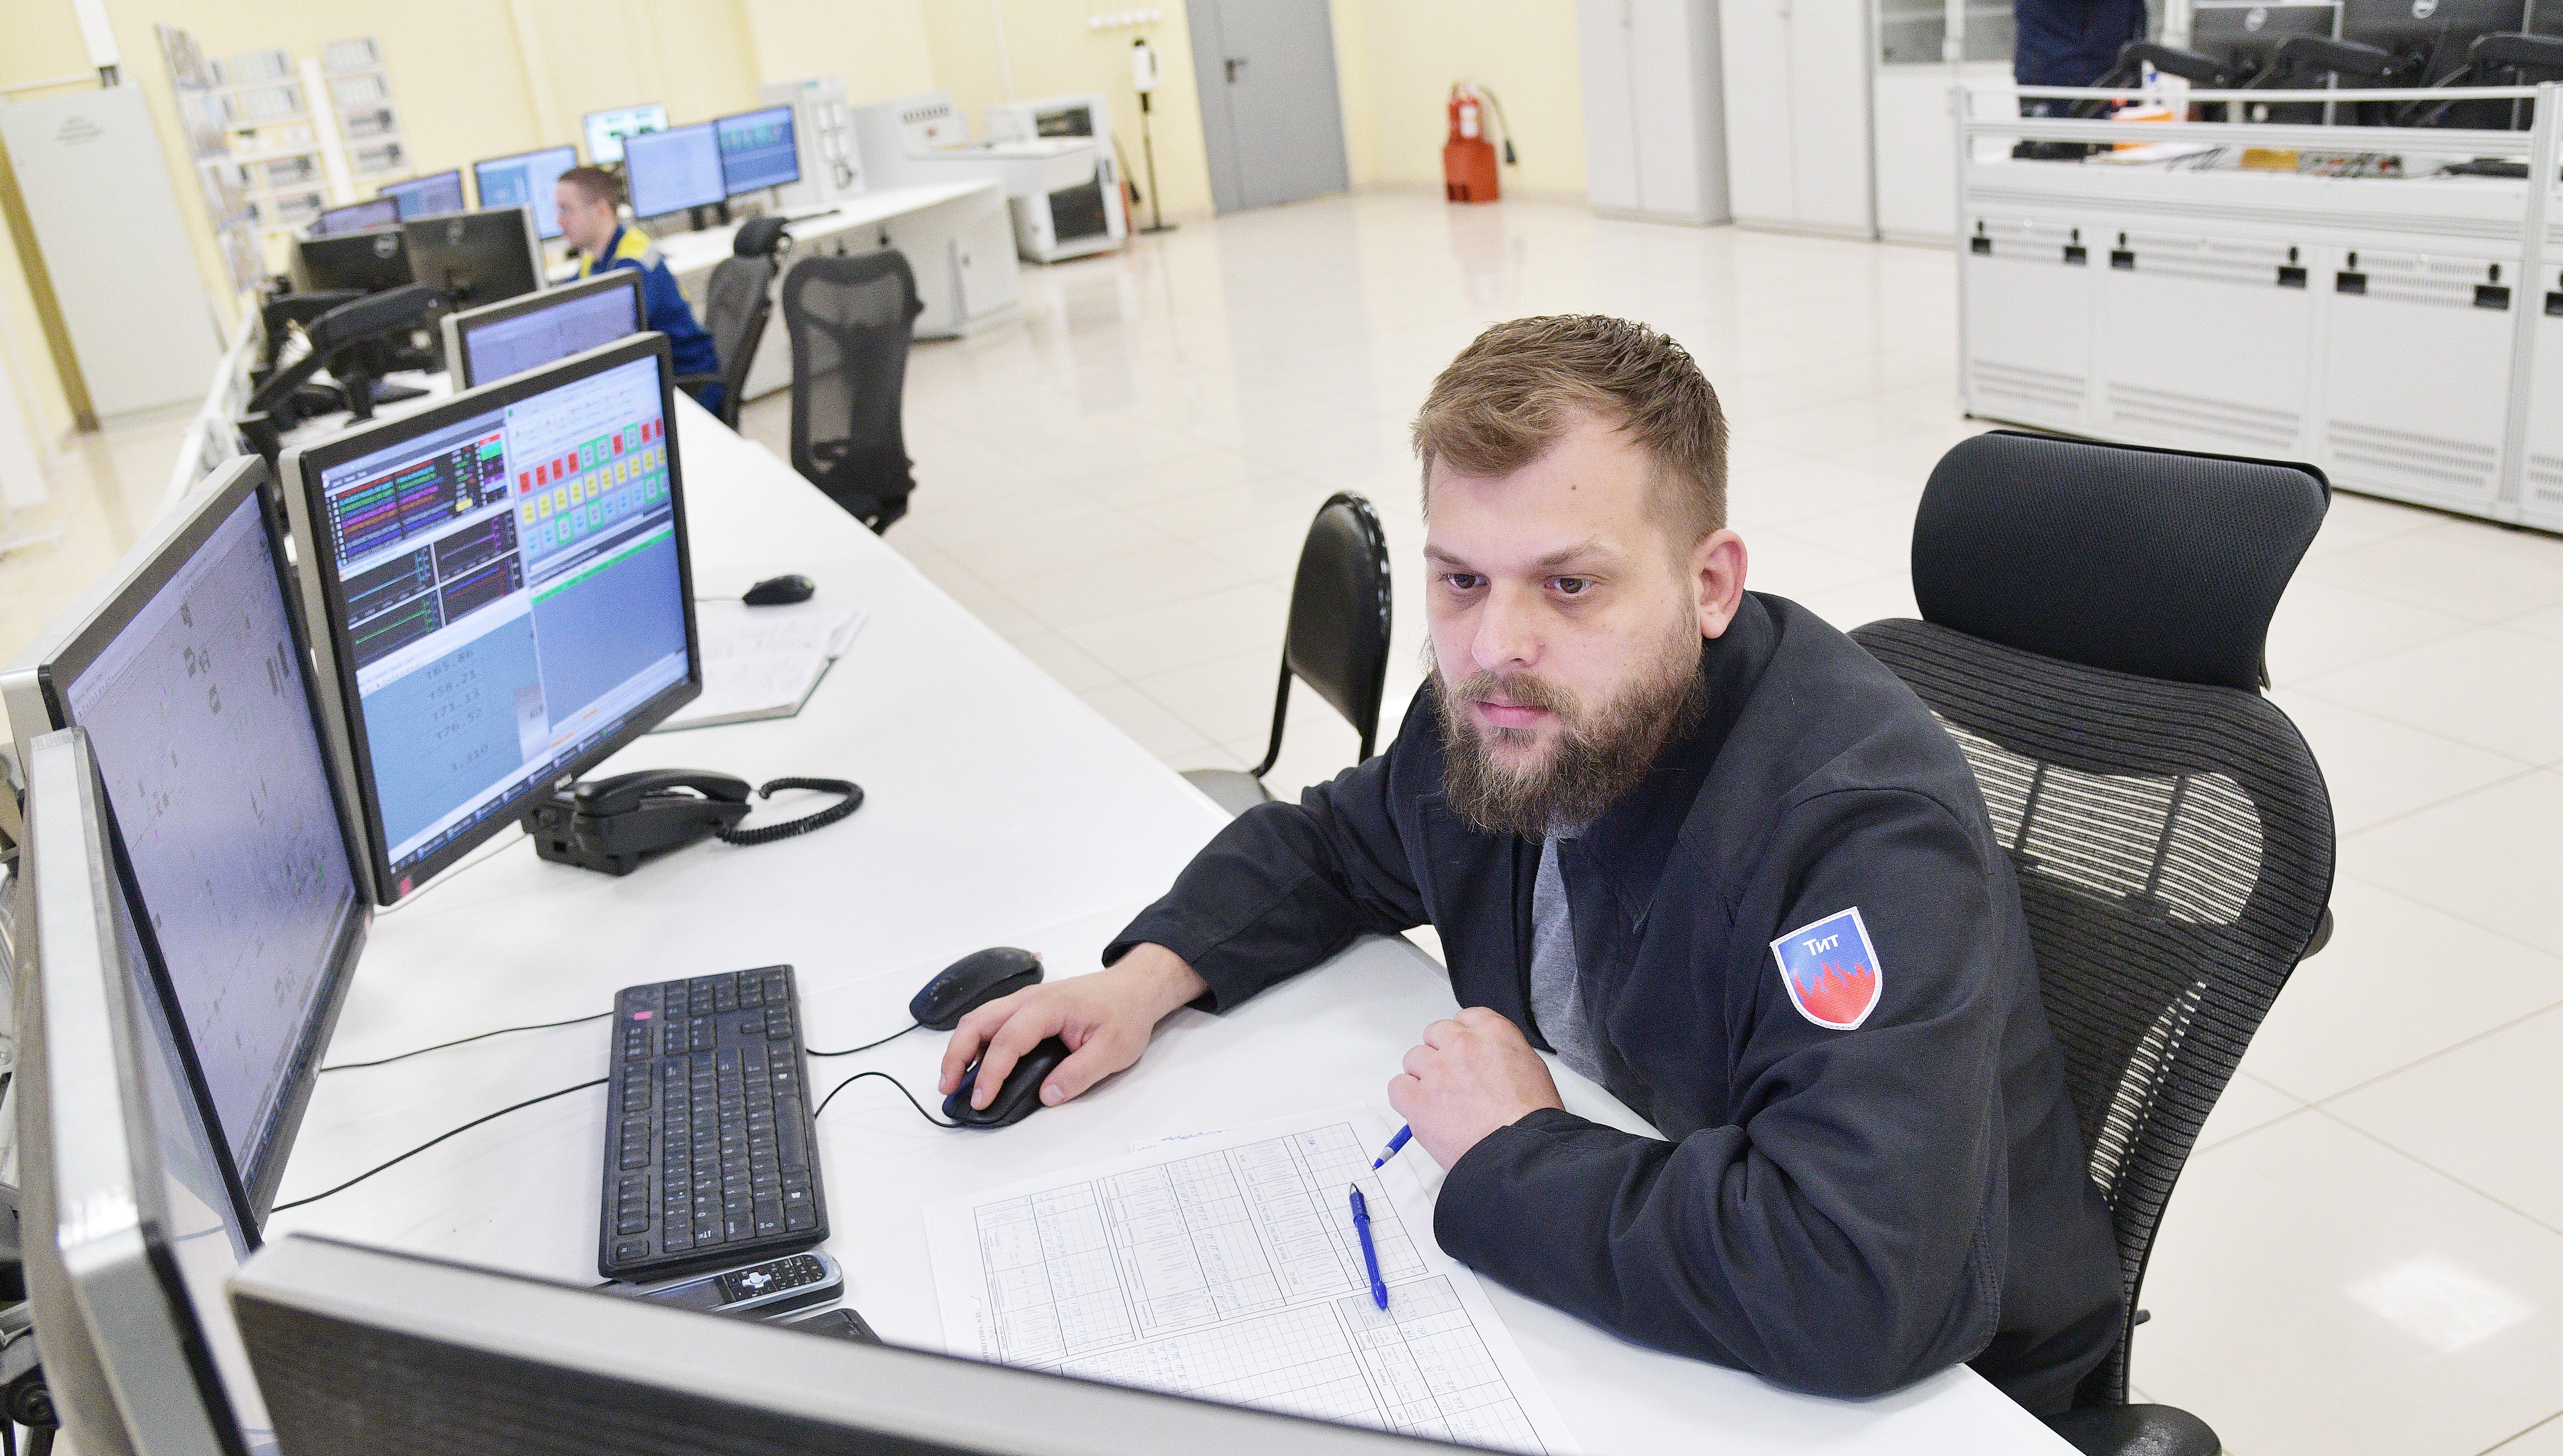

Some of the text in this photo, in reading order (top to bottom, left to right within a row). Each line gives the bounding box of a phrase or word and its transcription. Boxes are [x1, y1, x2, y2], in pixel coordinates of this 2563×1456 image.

[1802, 933, 1839, 956] Тит
[1288, 1271, 1299, 1285] РОУ-12
[1375, 1368, 1390, 1386] Генератор
